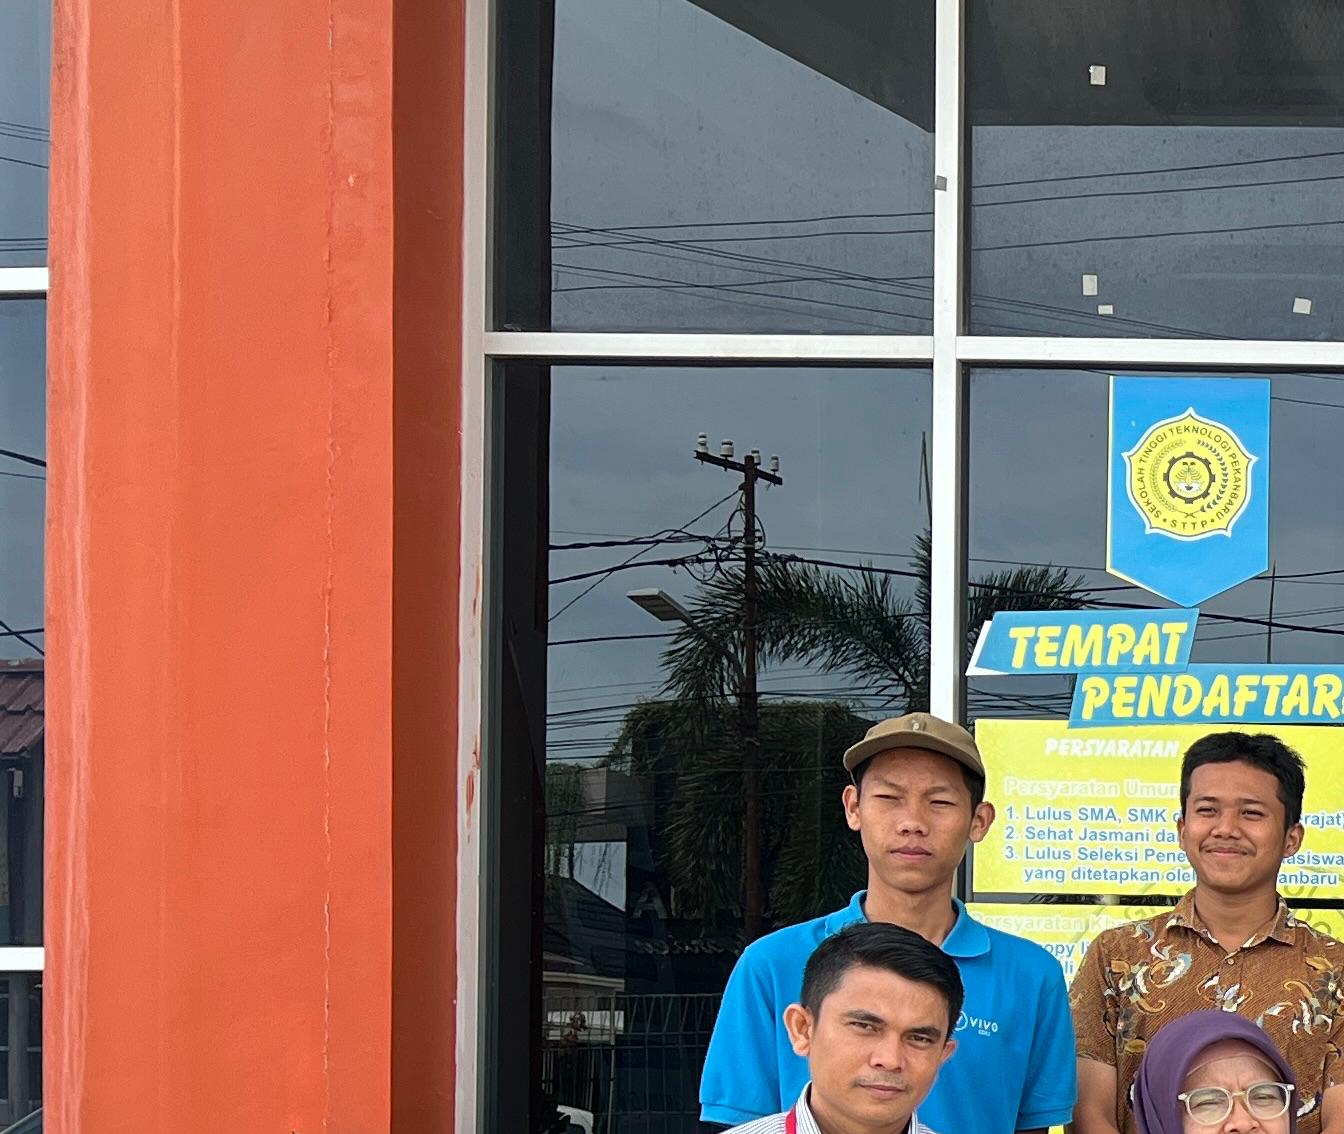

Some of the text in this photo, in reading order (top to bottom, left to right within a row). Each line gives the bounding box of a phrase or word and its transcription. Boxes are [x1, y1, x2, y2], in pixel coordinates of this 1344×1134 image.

[1137, 425, 1242, 521] SEKOLAH TINGGI TEKNOLOGI PEKANBARU
[1008, 622, 1189, 670] TEMPAT
[1044, 738, 1179, 758] PERSYARATAN
[1005, 779, 1119, 797] Persyaratan
[1006, 806, 1019, 820] 1.
[1025, 806, 1072, 821] Lulus
[1078, 807, 1122, 823] SMA,
[1128, 808, 1167, 822] SMK
[1006, 827, 1019, 840] 2.
[1025, 827, 1073, 841] Sehat
[1079, 828, 1150, 842] Jasmani
[1005, 847, 1018, 860] 3.
[1025, 847, 1072, 861] Lulus
[1078, 847, 1139, 862] Seleksi
[1024, 869, 1065, 882] yang
[1071, 867, 1160, 883] ditetapkan
[1279, 871, 1337, 885] anbaru
